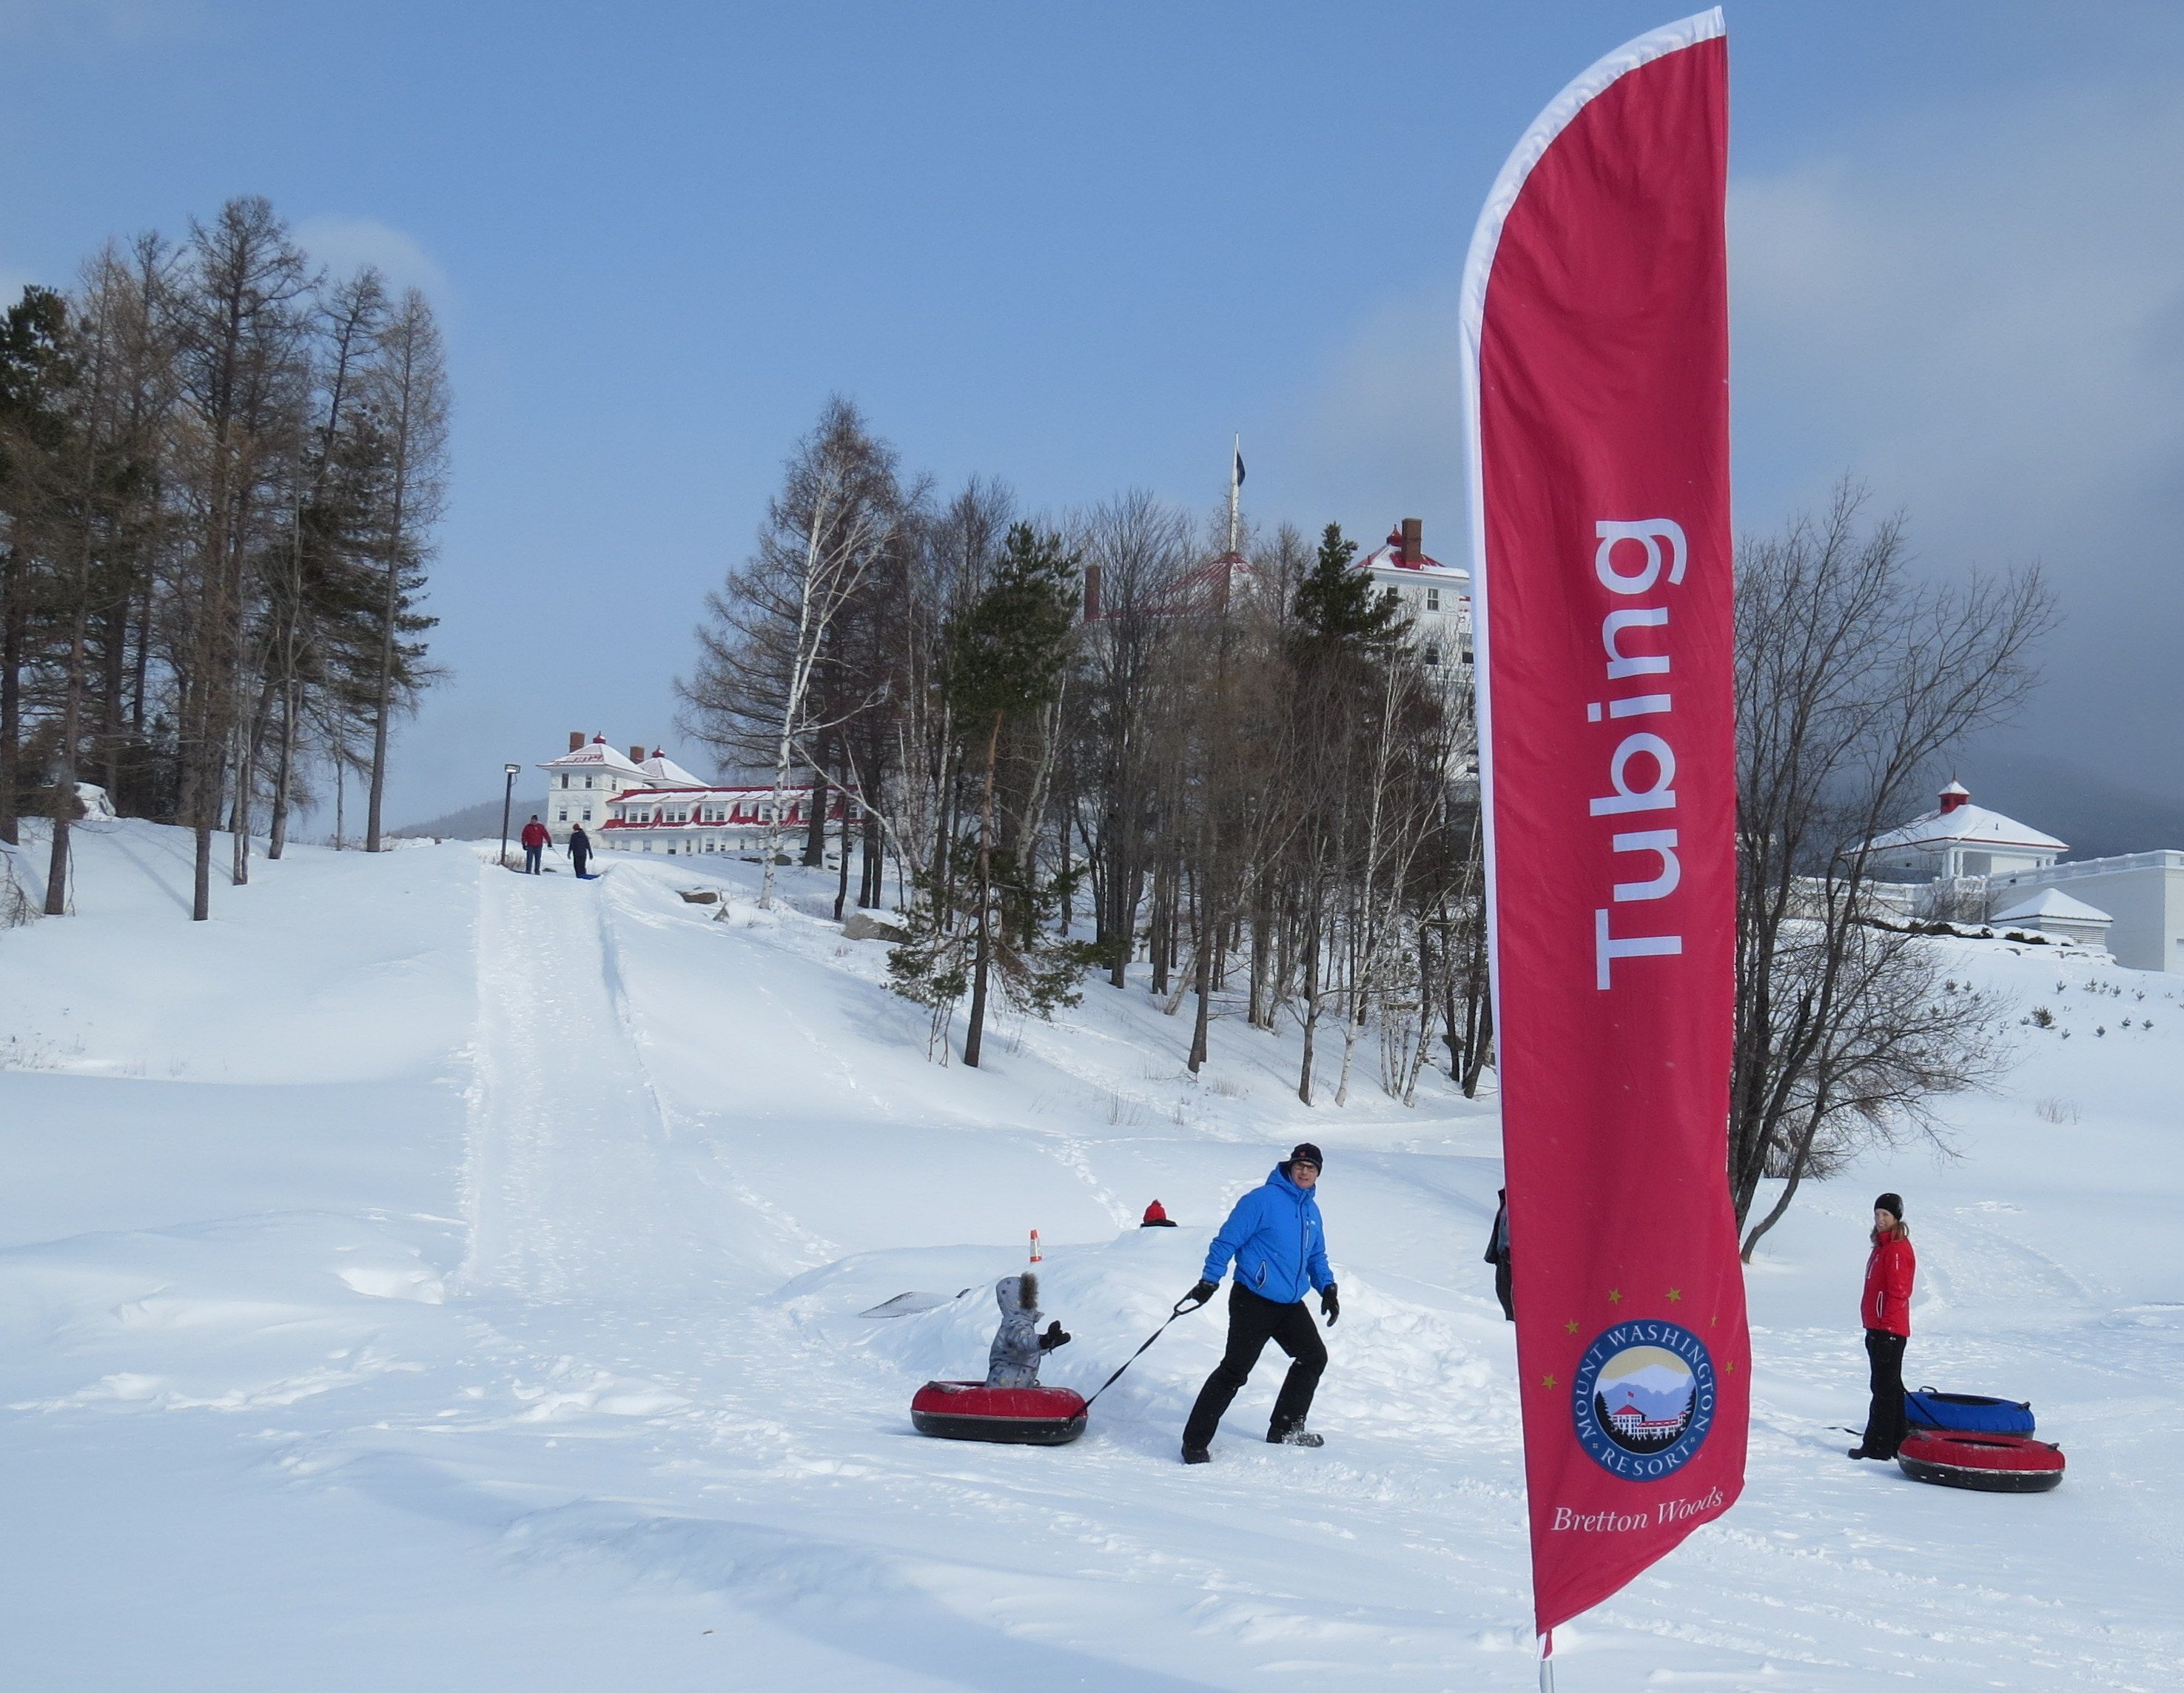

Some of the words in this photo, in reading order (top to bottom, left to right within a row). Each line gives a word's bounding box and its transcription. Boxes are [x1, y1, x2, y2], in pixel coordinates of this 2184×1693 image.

[1587, 517, 1687, 990] Tubing
[1576, 1342, 1606, 1440] MOUNT
[1607, 1324, 1713, 1432] WASHINGTON
[1601, 1441, 1690, 1476] RESORT
[1551, 1507, 1648, 1532] Bretton
[1657, 1485, 1724, 1525] Woods
